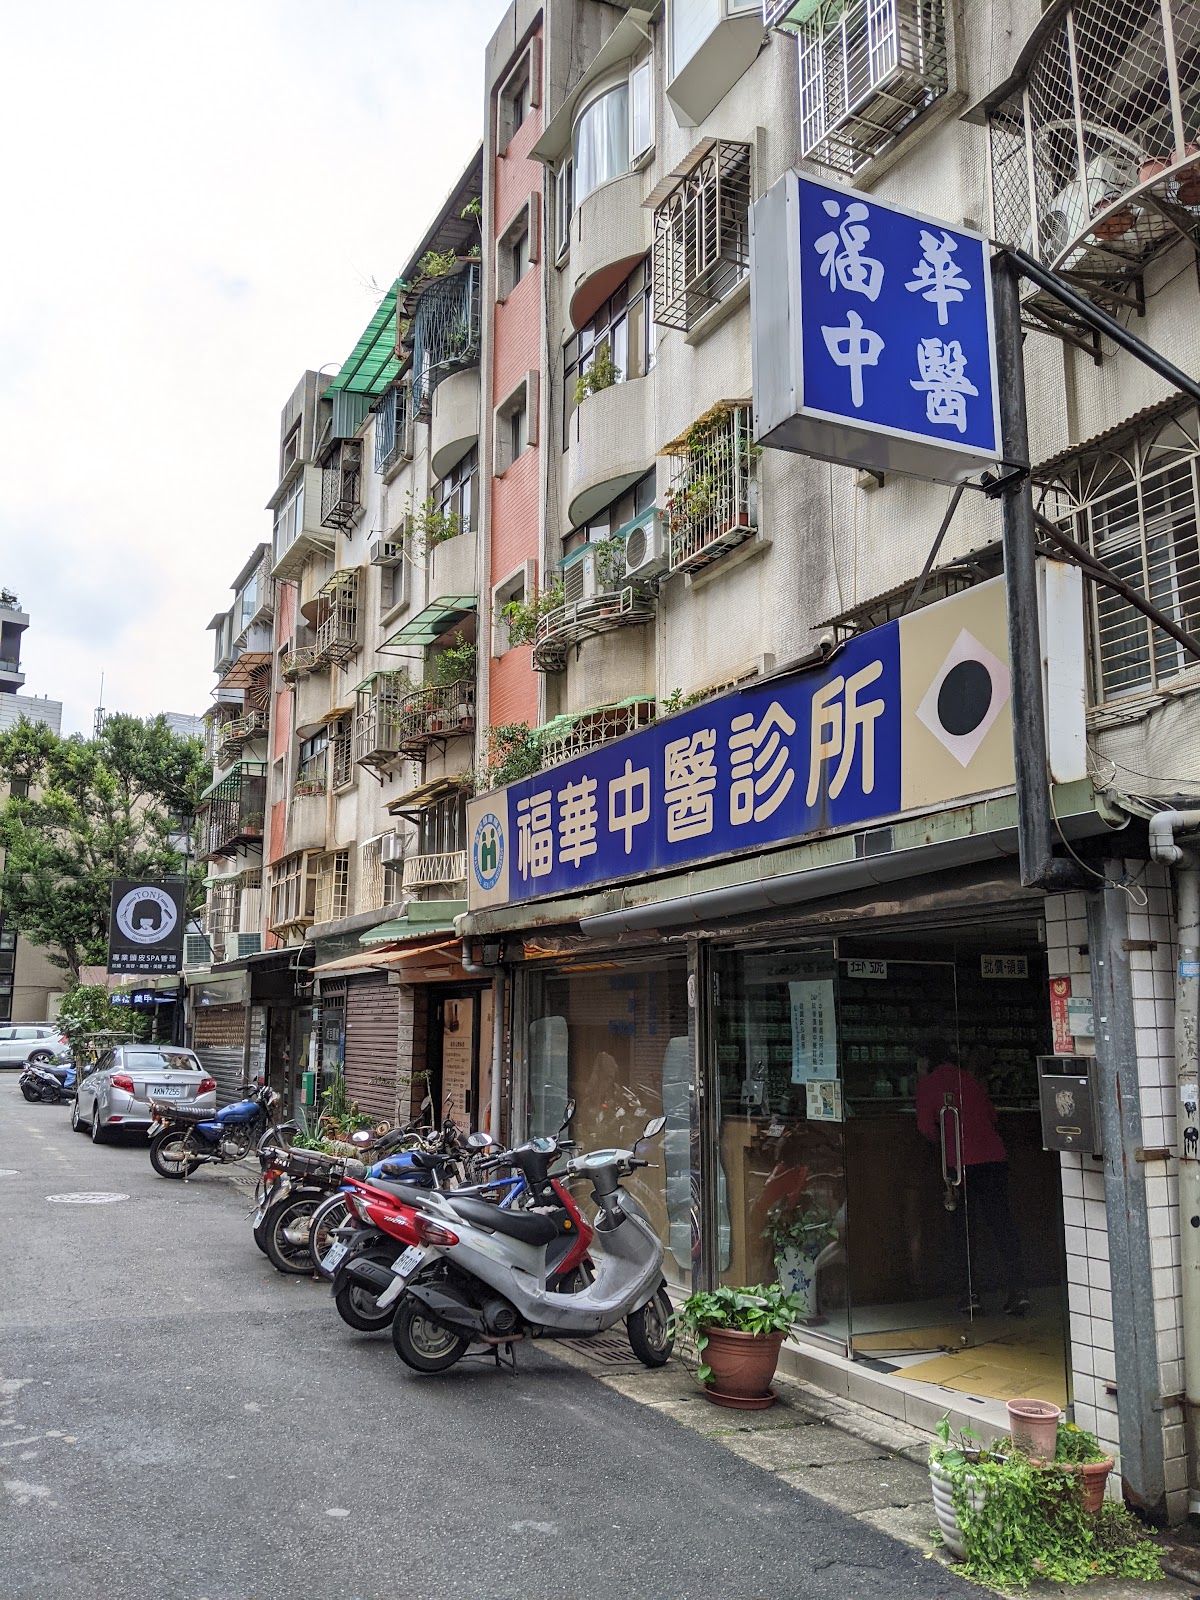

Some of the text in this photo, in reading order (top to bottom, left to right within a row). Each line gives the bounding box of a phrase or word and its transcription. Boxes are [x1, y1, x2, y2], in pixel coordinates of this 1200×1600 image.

[813, 199, 972, 326] 福華
[820, 310, 980, 434] 中醫
[516, 659, 885, 881] 福華中醫診所
[135, 890, 164, 900] TONY
[111, 953, 177, 963] 專業頭皮SPA管理
